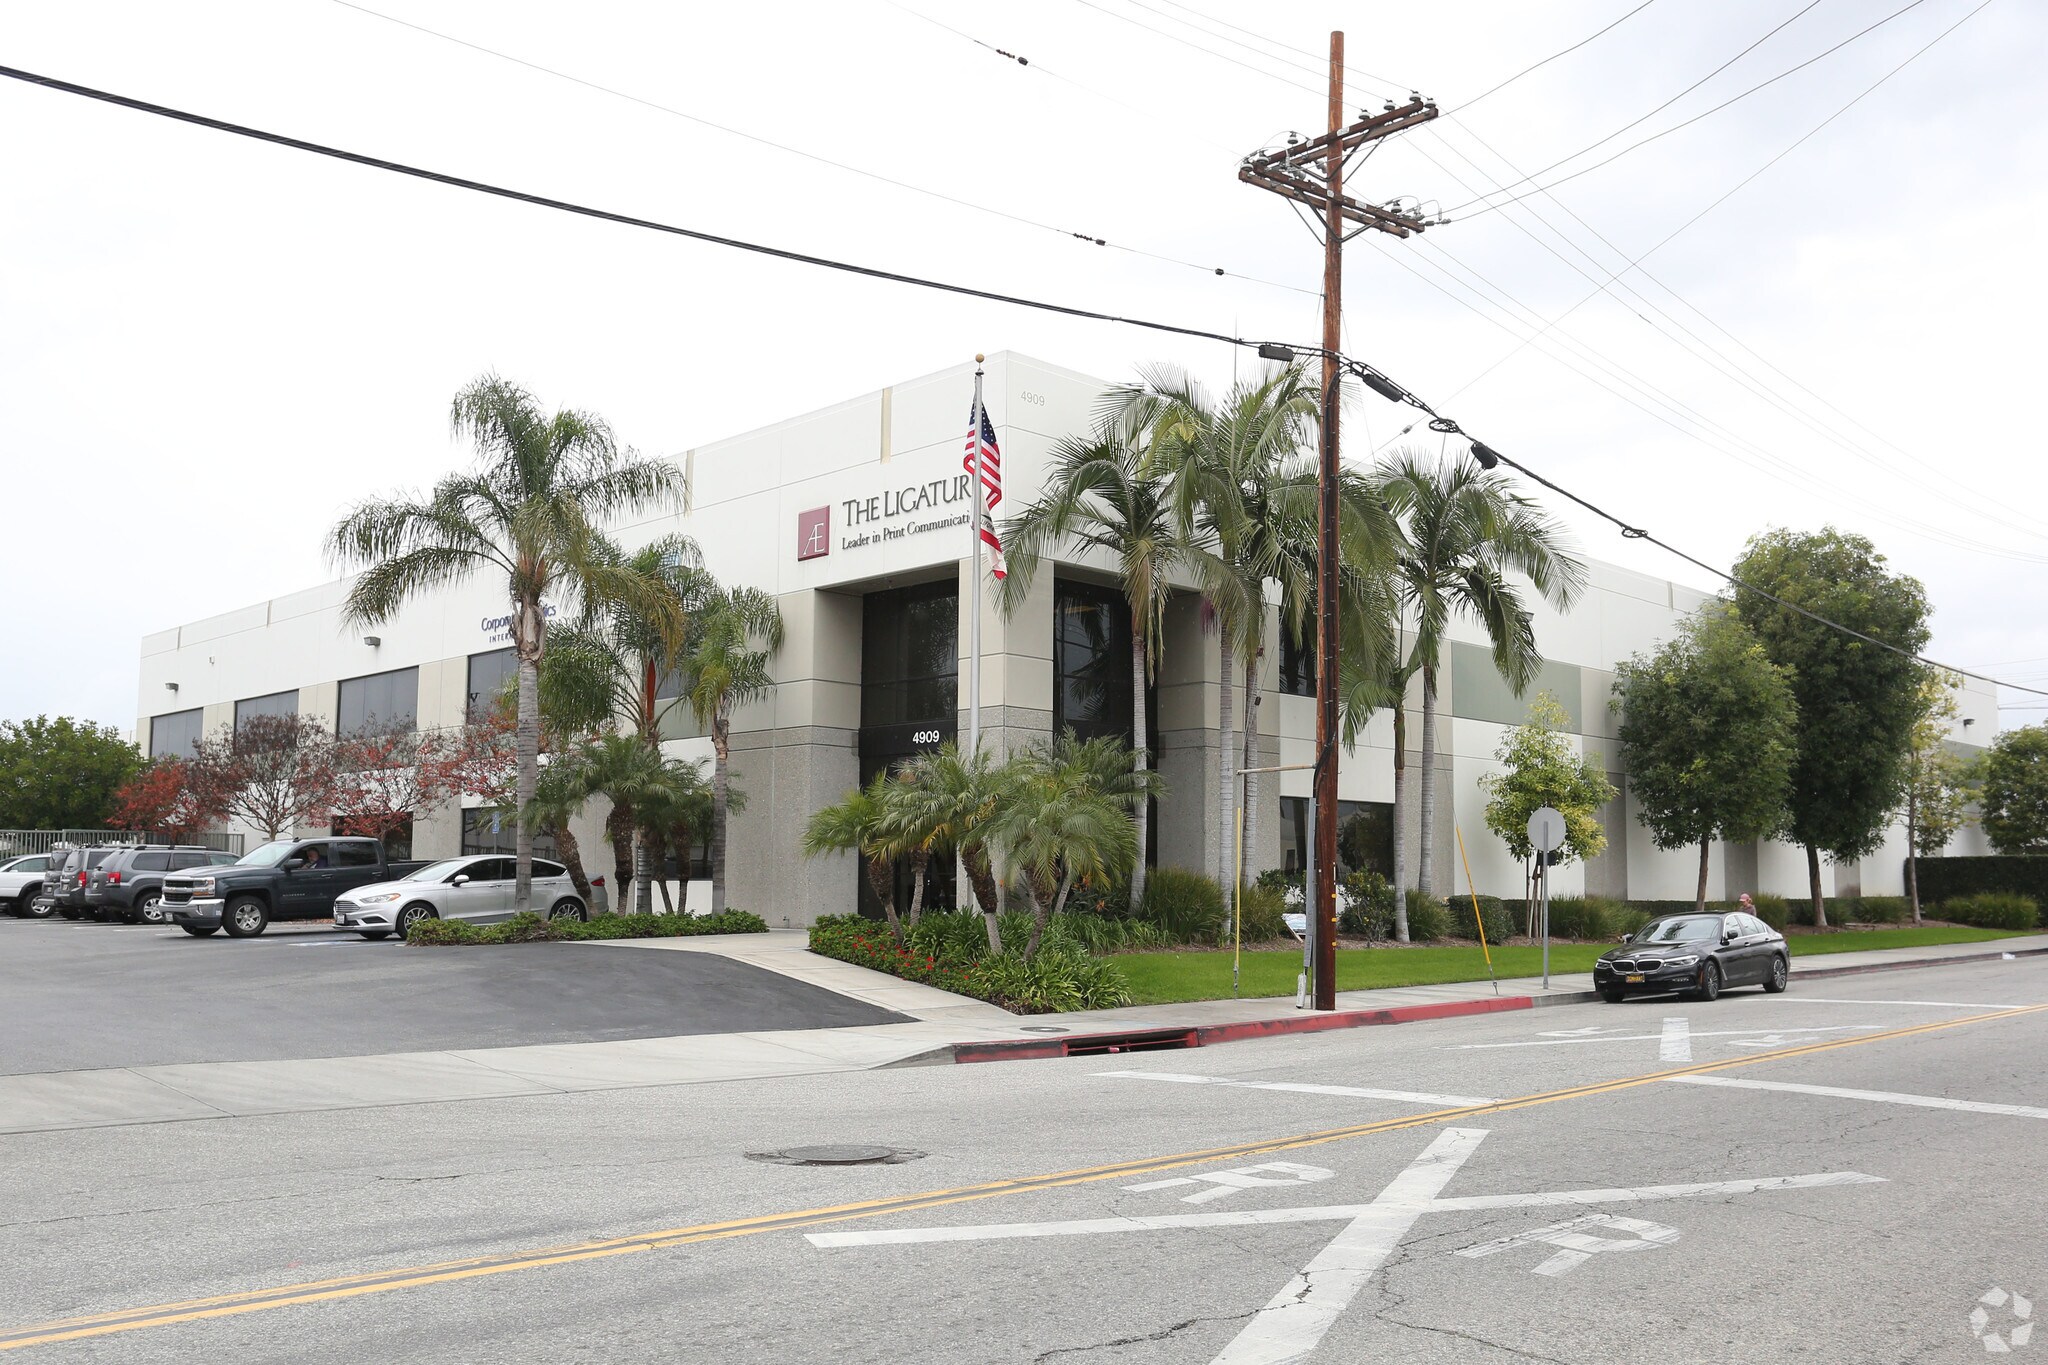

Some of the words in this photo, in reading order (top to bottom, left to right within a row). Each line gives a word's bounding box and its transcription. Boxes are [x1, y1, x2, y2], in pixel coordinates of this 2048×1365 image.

[1020, 390, 1045, 407] 4909
[842, 496, 880, 527] THE
[884, 474, 974, 518] LIGATUR
[841, 533, 870, 550] Leader
[873, 530, 881, 543] in
[883, 526, 905, 541] Print
[906, 509, 972, 535] Communicati
[481, 615, 512, 632] Corpora
[912, 729, 940, 744] 4909
